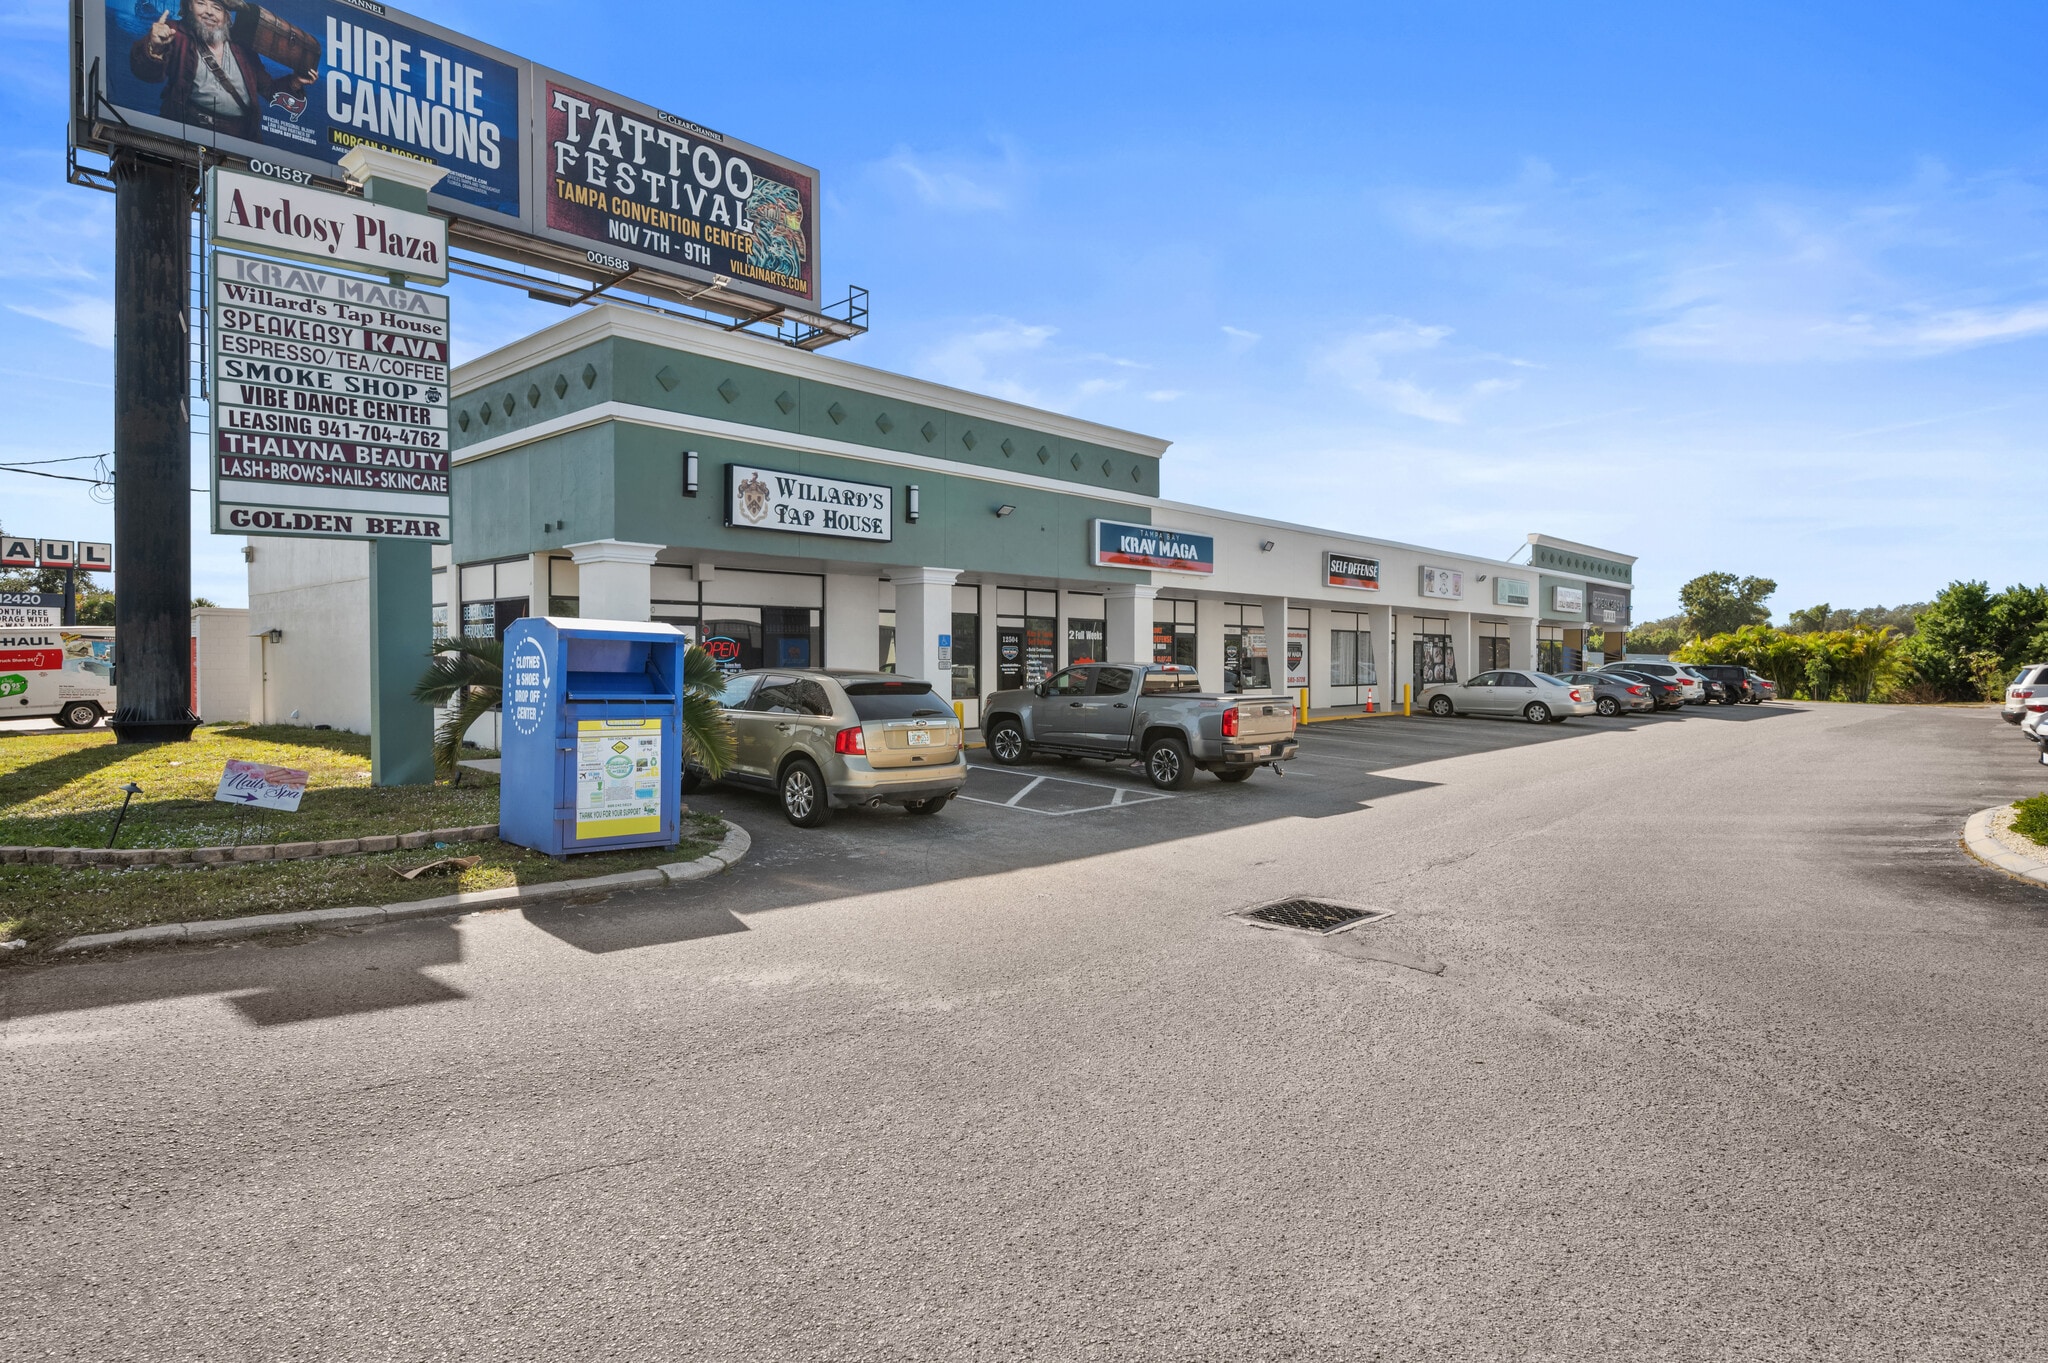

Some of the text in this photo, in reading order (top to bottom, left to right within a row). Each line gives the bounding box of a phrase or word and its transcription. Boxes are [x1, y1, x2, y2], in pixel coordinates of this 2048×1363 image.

[327, 16, 483, 118] HIRE THE
[326, 70, 500, 170] CANNONS
[333, 130, 378, 151] MORGAN
[552, 90, 754, 200] TATTOO
[250, 159, 312, 185] 001587
[554, 141, 754, 234] FESTIVAL
[224, 188, 440, 264] Ardosy Plaza
[556, 178, 754, 256] TAMPA CONVENTION CENTER
[608, 219, 640, 245] NOV
[643, 228, 670, 255] 7TH
[684, 242, 711, 266] 9TH
[586, 250, 630, 271] 001588
[730, 259, 807, 293] VILLAINARTS.COM
[236, 259, 431, 315] KRAV MAGA
[224, 283, 443, 336] Willard's Tap House
[223, 309, 441, 361] SPEAKEASY KAVA
[225, 360, 418, 400] SMOKE SHOP
[240, 384, 431, 426] VIBE DANCE CENTER
[228, 409, 441, 448] LEASING 941-704-4762
[224, 433, 444, 471] THALYNA BEAUTY
[775, 476, 884, 510] WILLARD'S
[230, 509, 441, 538] GOLDEN BEAR
[774, 503, 884, 535] TAP HOUSE
[1140, 529, 1181, 541] TAMPA BAY
[1120, 535, 1199, 560] KRAV MAGA
[1330, 560, 1378, 578] SELF DEFENSE
[702, 641, 741, 657] OPEN
[1069, 630, 1103, 640] 2 Full Weeks
[516, 655, 540, 669] CLOTHES
[516, 673, 540, 686] & SHOES
[515, 690, 540, 703] DROP OFF
[517, 707, 537, 721] CENTER
[224, 773, 300, 799] Nails Spa
[579, 807, 641, 820] THANK YOU FOR YOUR SUPPORT
